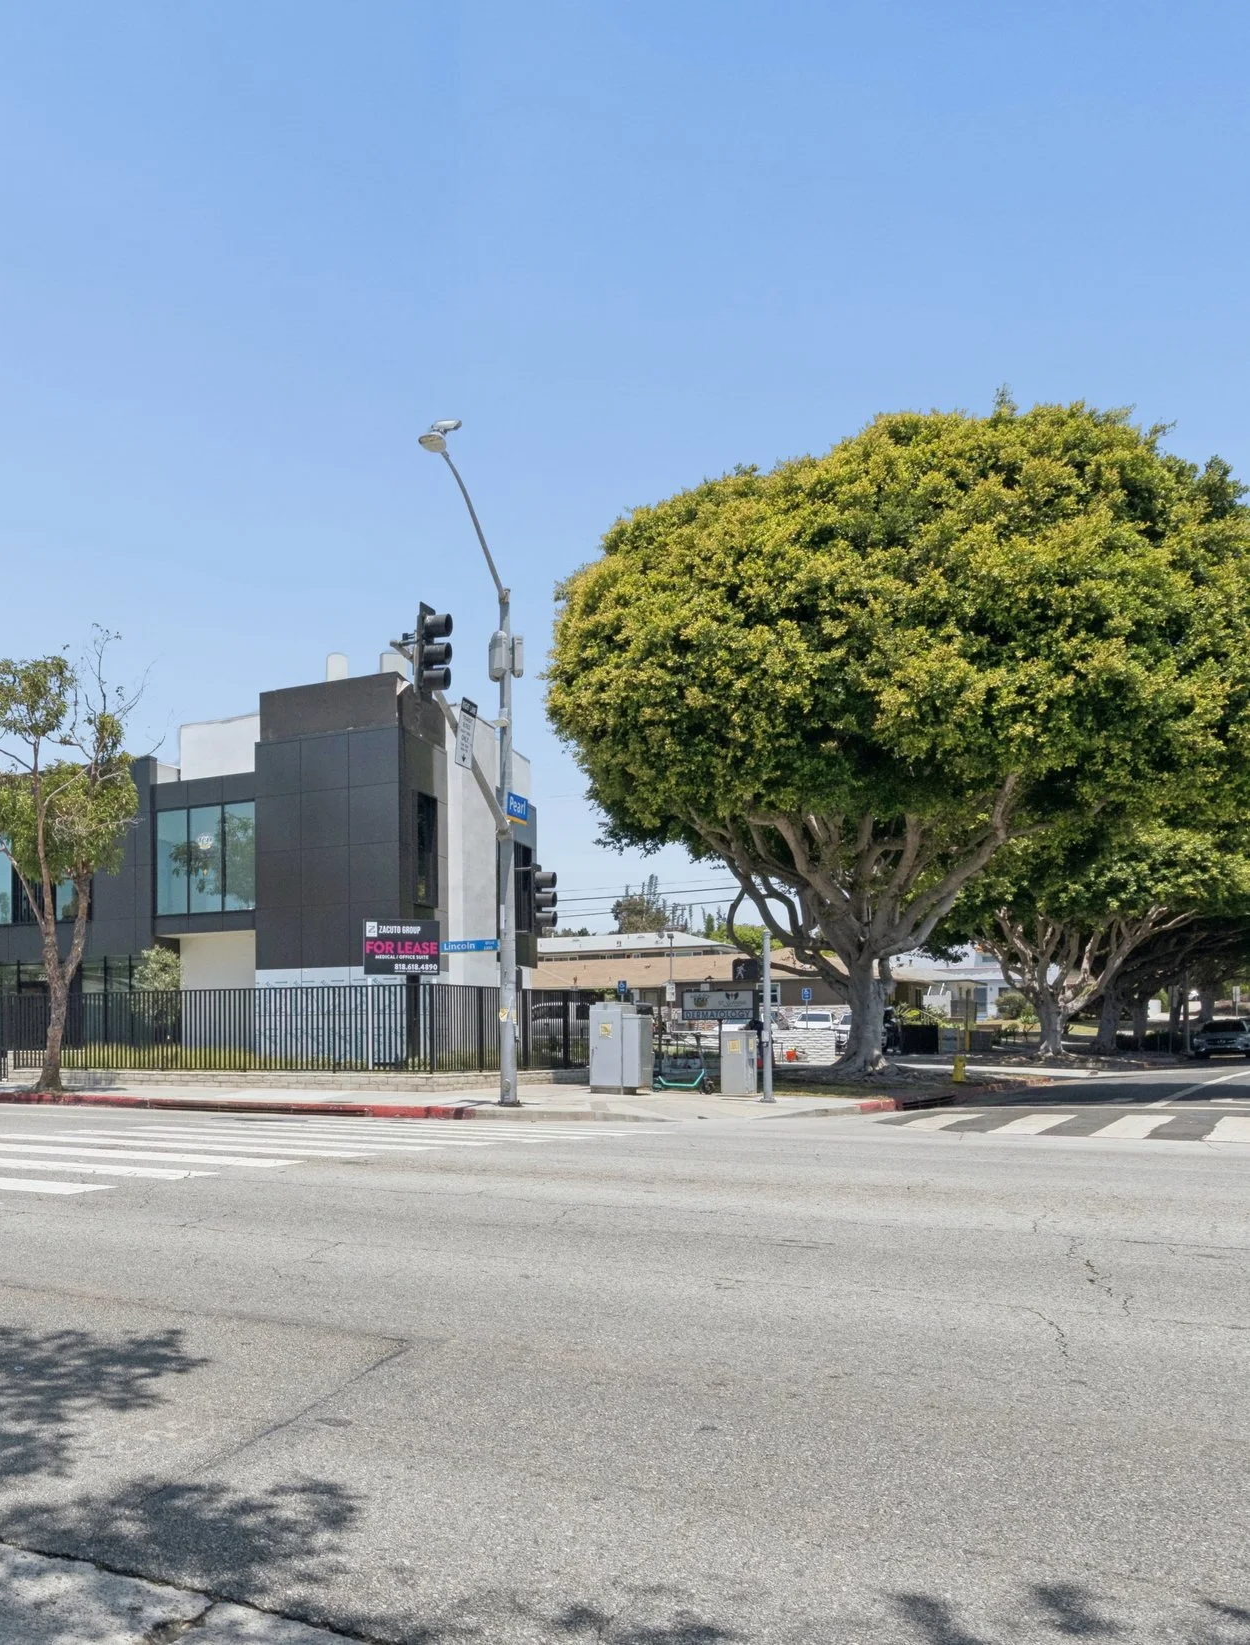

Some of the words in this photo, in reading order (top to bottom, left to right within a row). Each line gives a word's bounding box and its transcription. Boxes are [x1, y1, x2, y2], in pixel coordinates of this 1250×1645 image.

[510, 796, 526, 815] Pearl
[378, 925, 401, 934] ZACUTO
[402, 926, 421, 934] GROUP
[366, 941, 394, 954] FOR
[397, 941, 438, 955] LEASE
[443, 942, 476, 951] Lincoln
[685, 1010, 750, 1019] DERMATOLOGY
